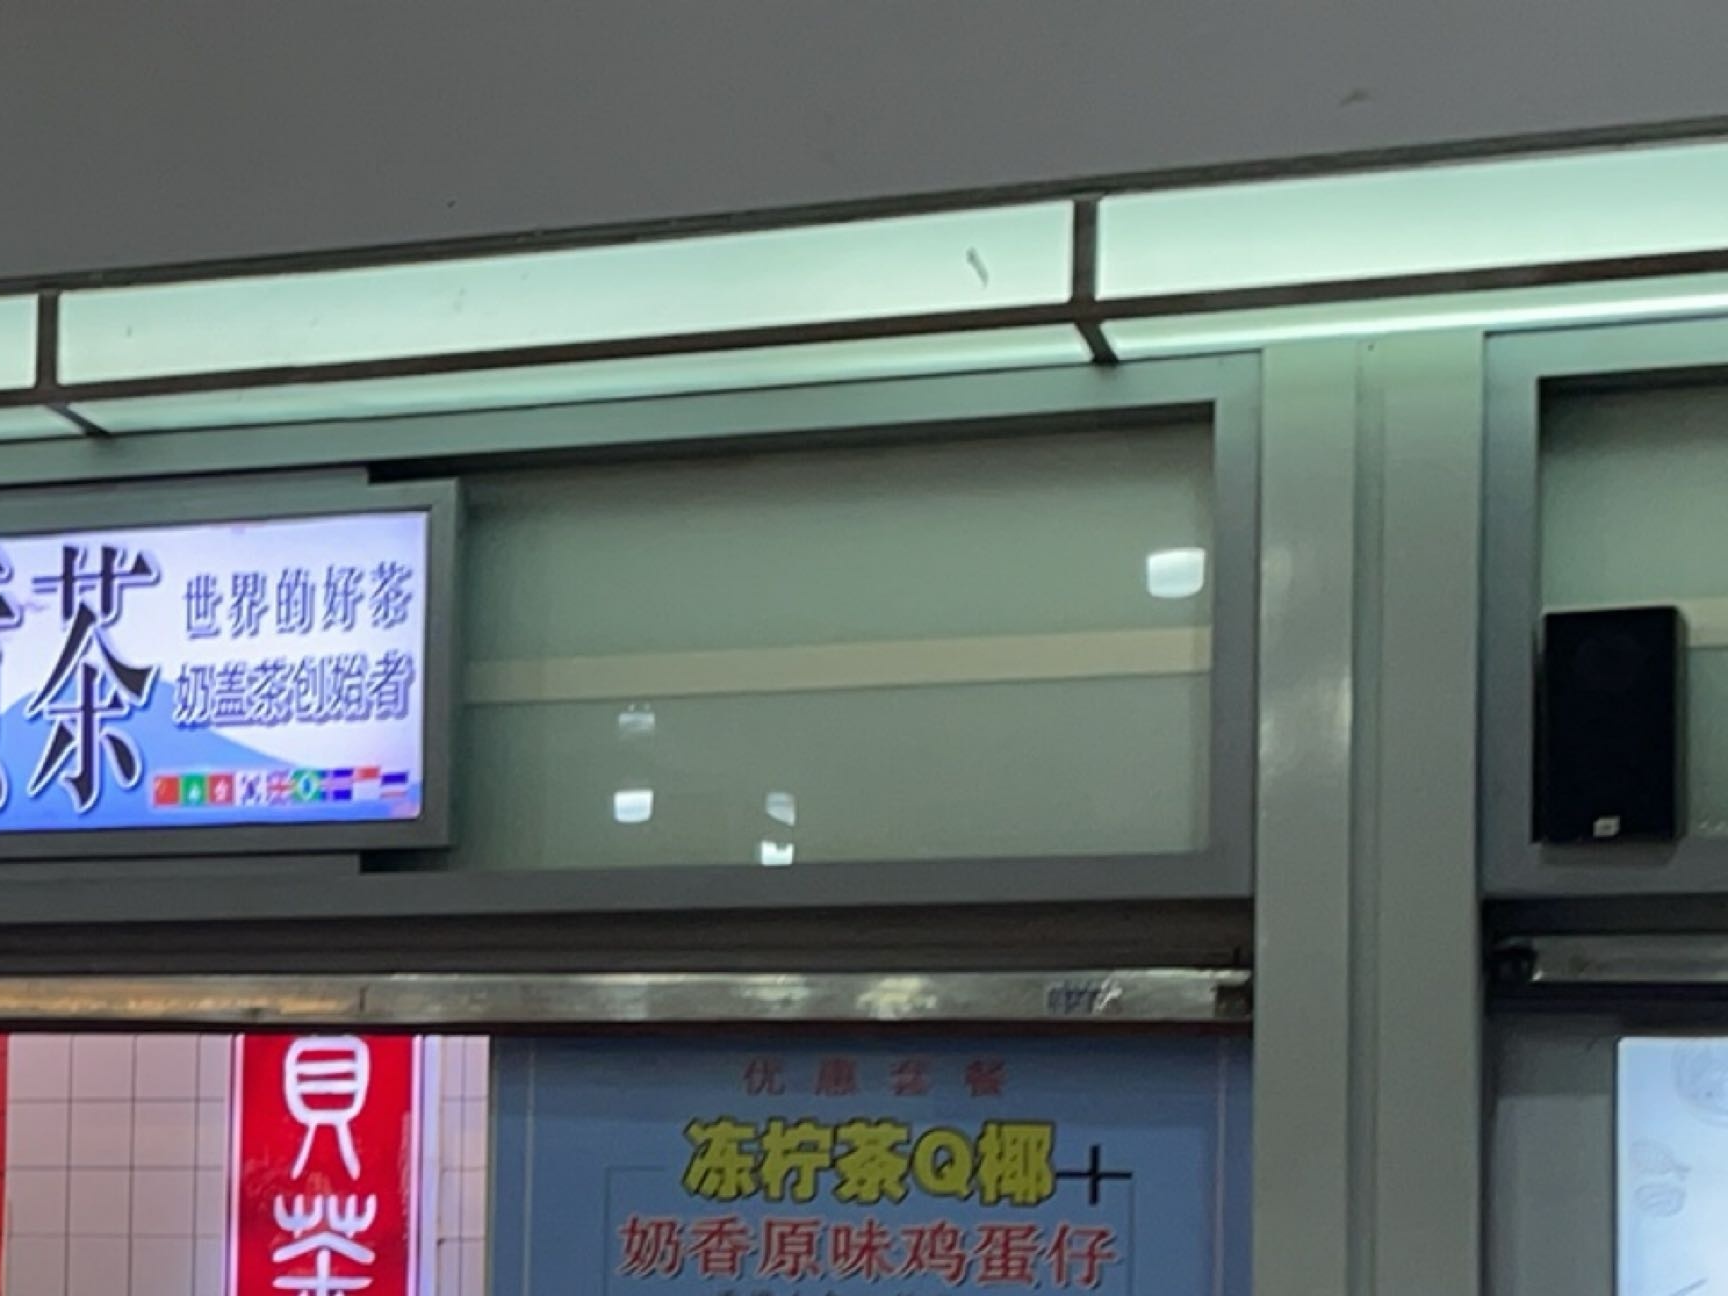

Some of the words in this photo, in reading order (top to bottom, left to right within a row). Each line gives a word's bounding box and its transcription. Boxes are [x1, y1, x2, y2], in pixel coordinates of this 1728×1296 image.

[184, 561, 413, 640] 世界的好茶
[172, 650, 414, 729] 奶盖茶创始者
[743, 1056, 1010, 1098] 优惠套餐
[616, 1214, 1121, 1290] 奶香原味鸡蛋仔
